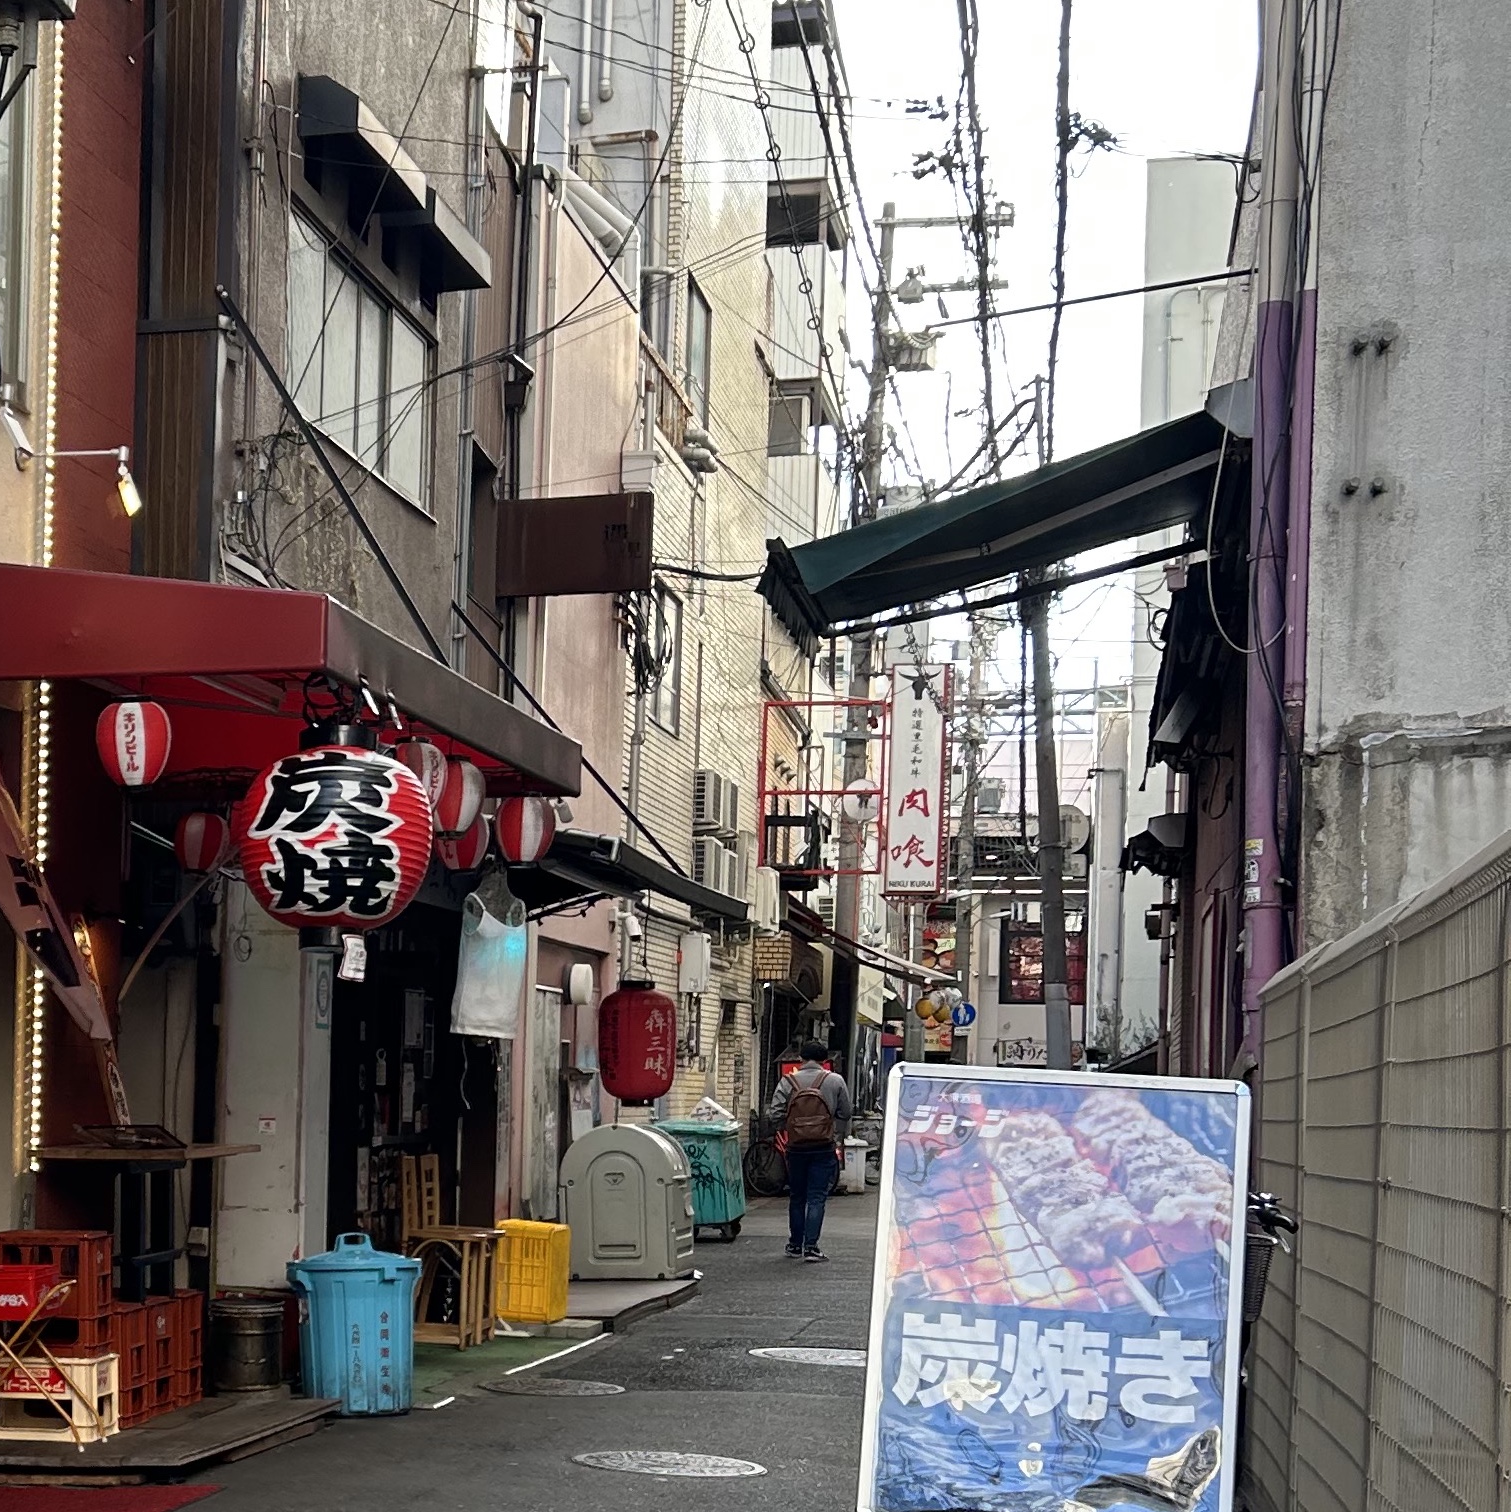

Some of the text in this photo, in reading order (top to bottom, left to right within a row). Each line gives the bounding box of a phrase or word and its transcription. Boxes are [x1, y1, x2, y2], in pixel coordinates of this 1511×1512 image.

[251, 750, 402, 917] 炭焼
[891, 788, 934, 868] 肉喰
[909, 880, 935, 888] KURAI
[908, 1104, 1010, 1138] ジョージ
[892, 1311, 1212, 1424] 炭焼き
